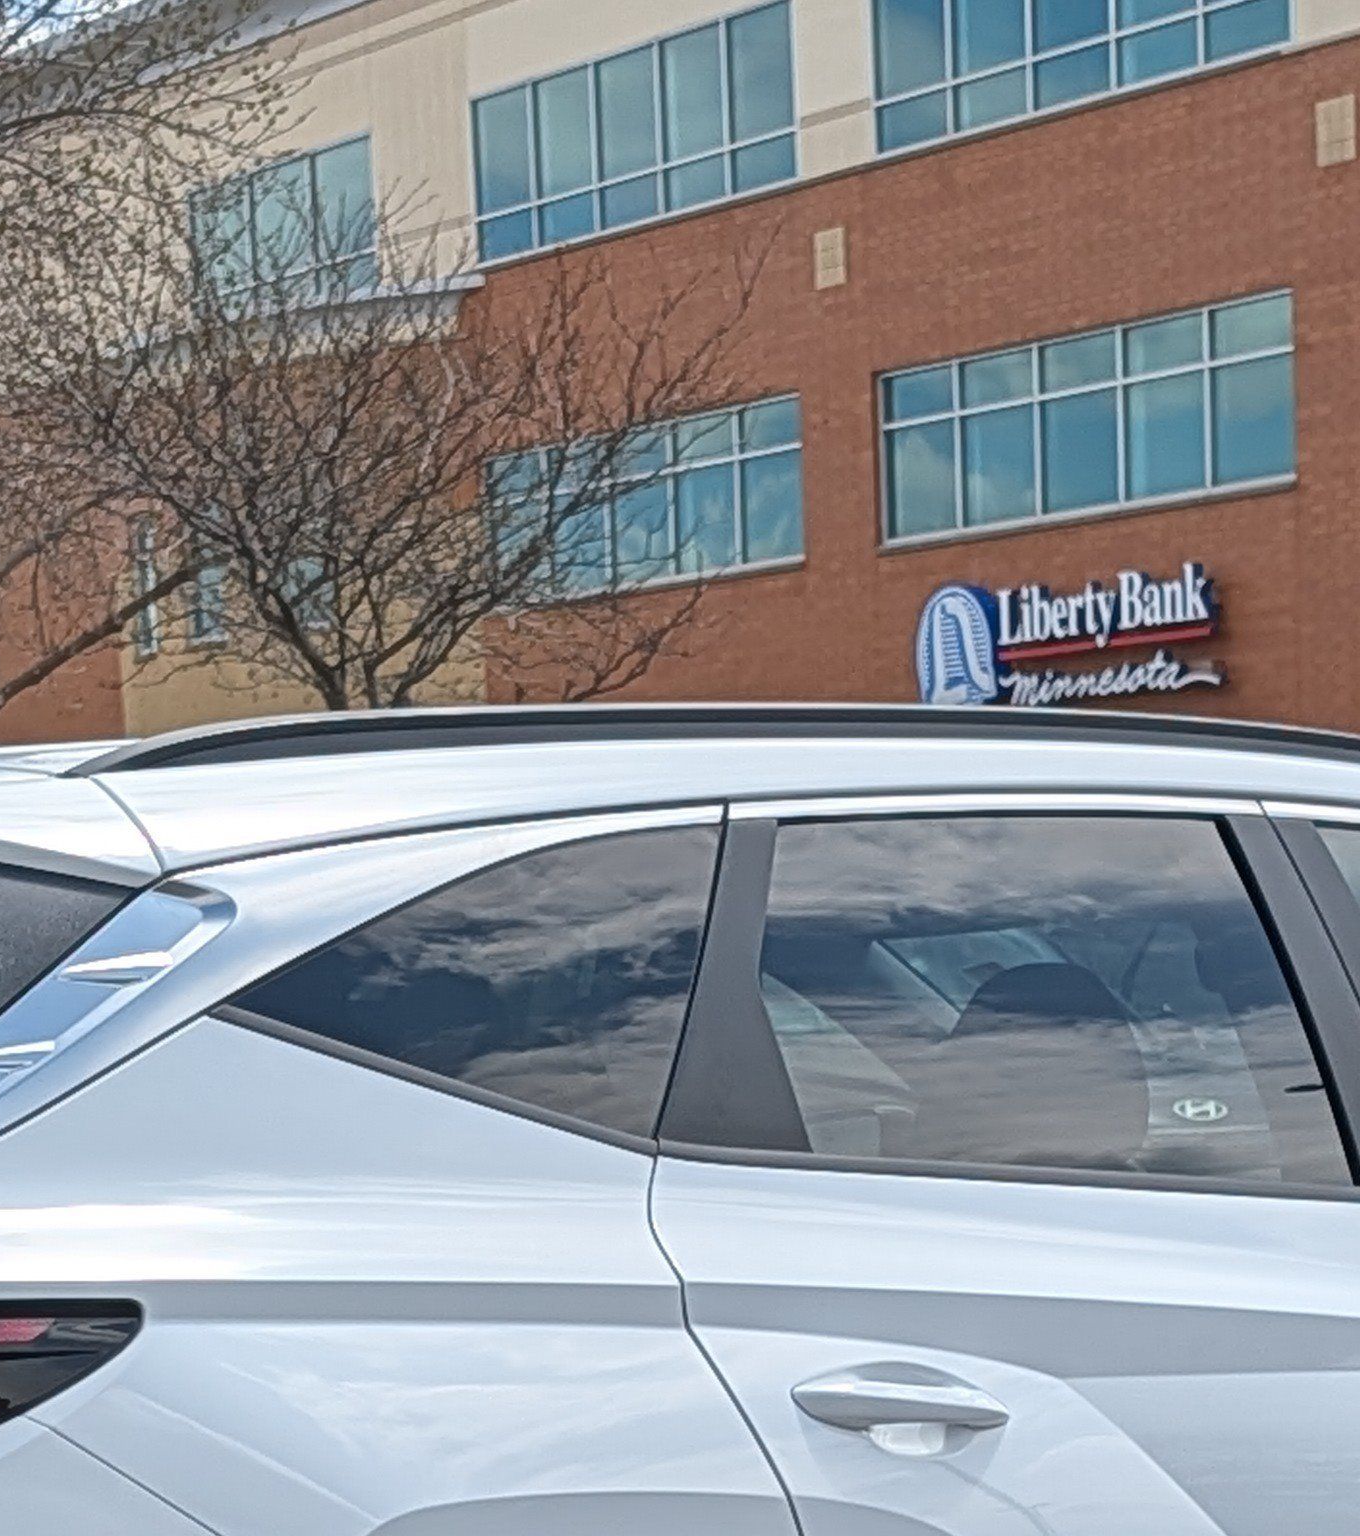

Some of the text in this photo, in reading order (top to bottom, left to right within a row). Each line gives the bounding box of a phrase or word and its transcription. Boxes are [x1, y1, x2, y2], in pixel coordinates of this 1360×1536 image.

[996, 560, 1210, 648] Liberty Bank
[998, 649, 1221, 706] Minnesota
